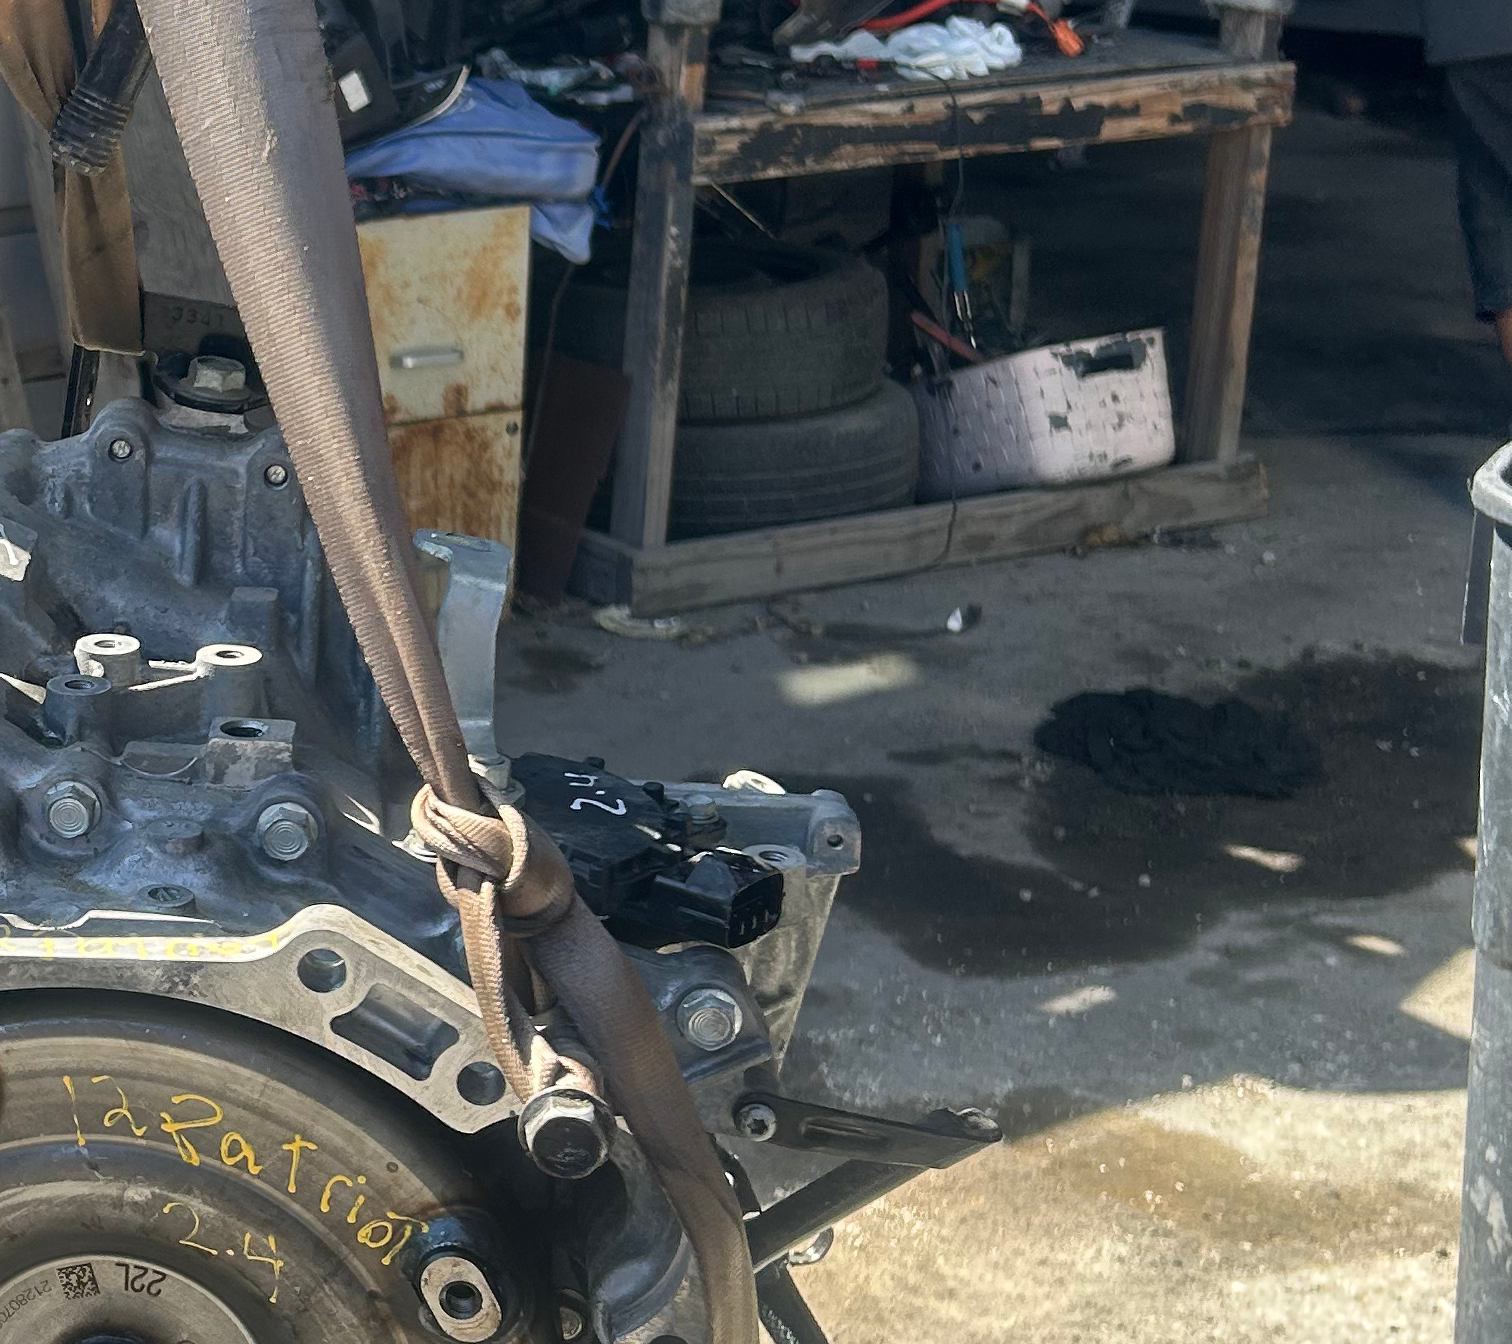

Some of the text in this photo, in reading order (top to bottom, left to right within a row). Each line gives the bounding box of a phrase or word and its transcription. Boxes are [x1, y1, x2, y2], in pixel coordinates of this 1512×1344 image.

[564, 772, 627, 815] 2.4
[62, 1074, 148, 1147] 12
[114, 1261, 168, 1298] 22L
[162, 1201, 285, 1304] 2.4
